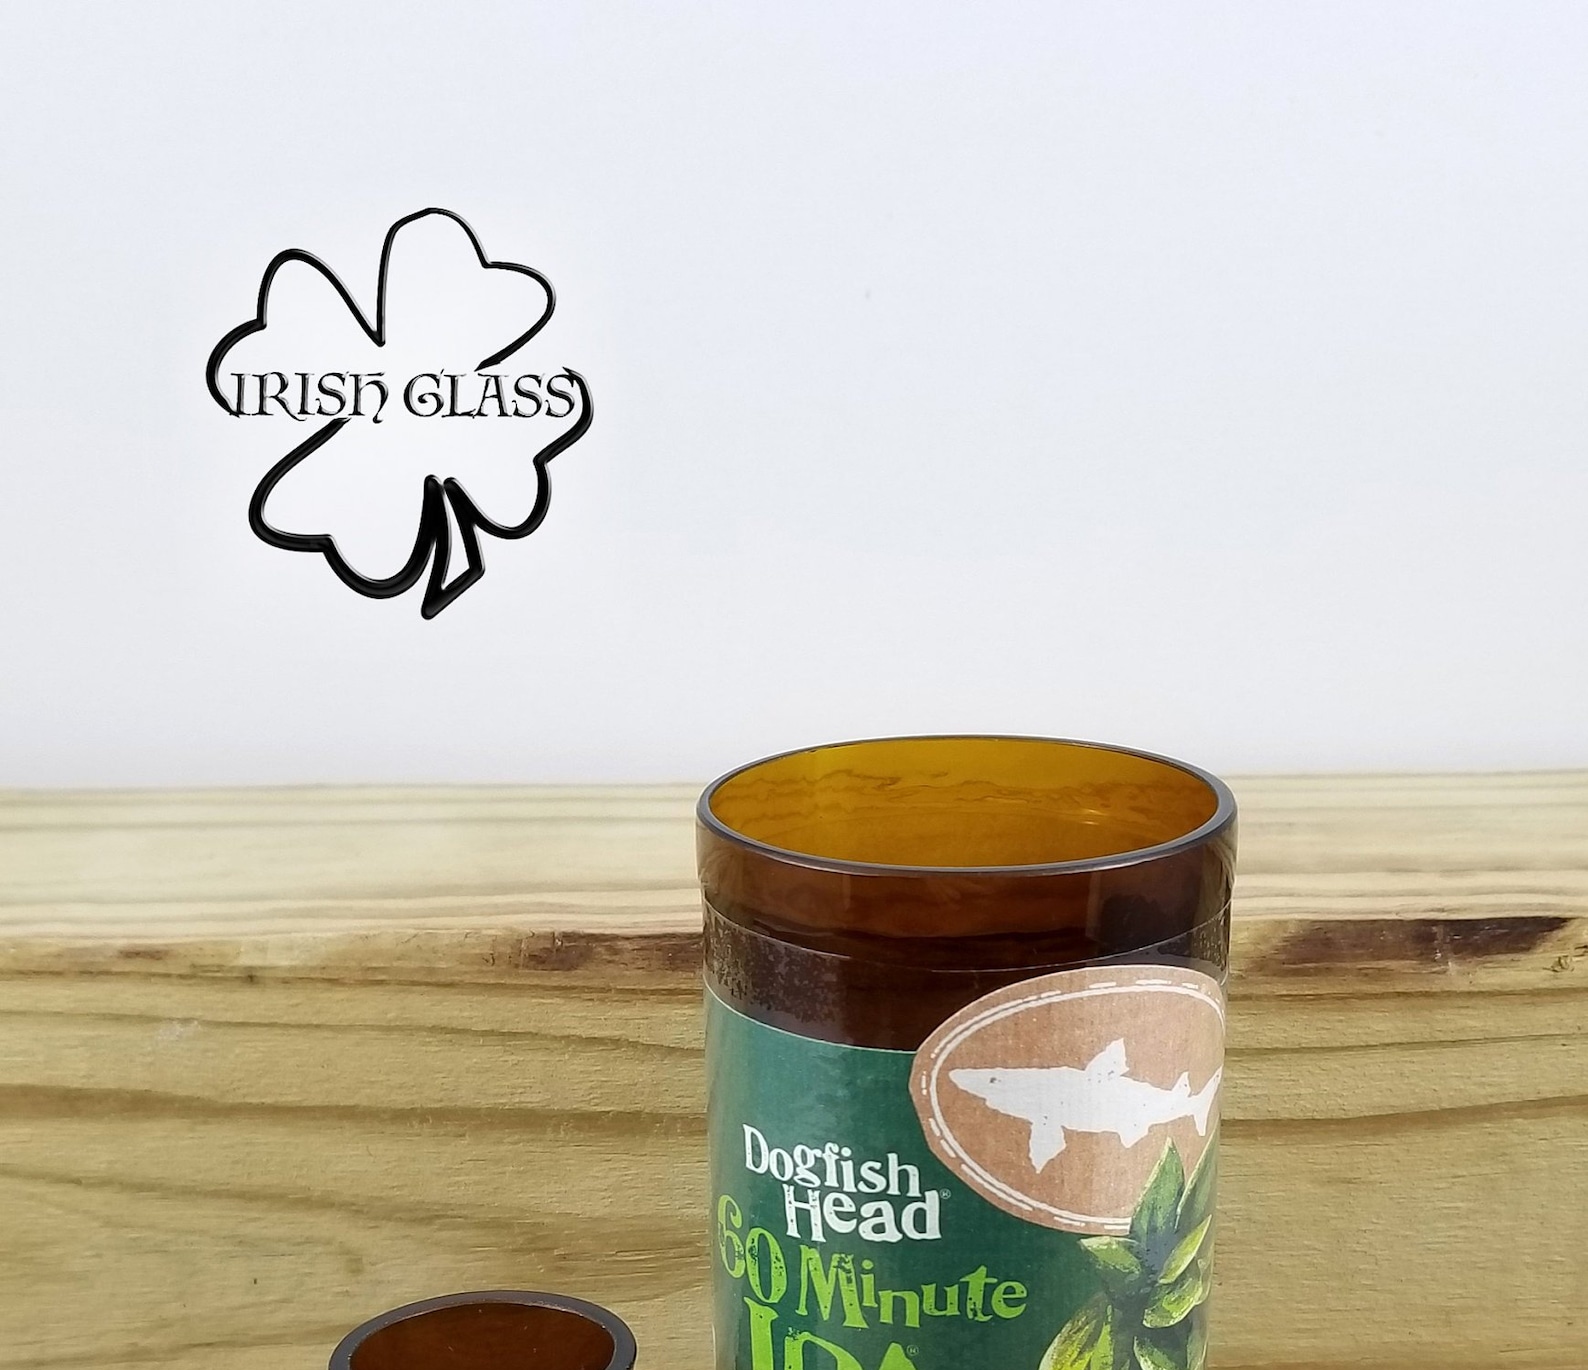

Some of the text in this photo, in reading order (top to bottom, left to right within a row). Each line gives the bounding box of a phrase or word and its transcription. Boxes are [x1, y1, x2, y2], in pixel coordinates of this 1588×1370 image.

[743, 1124, 921, 1197] Dogfish
[782, 1183, 942, 1243] Head
[718, 1195, 1029, 1329] 60 Minute
